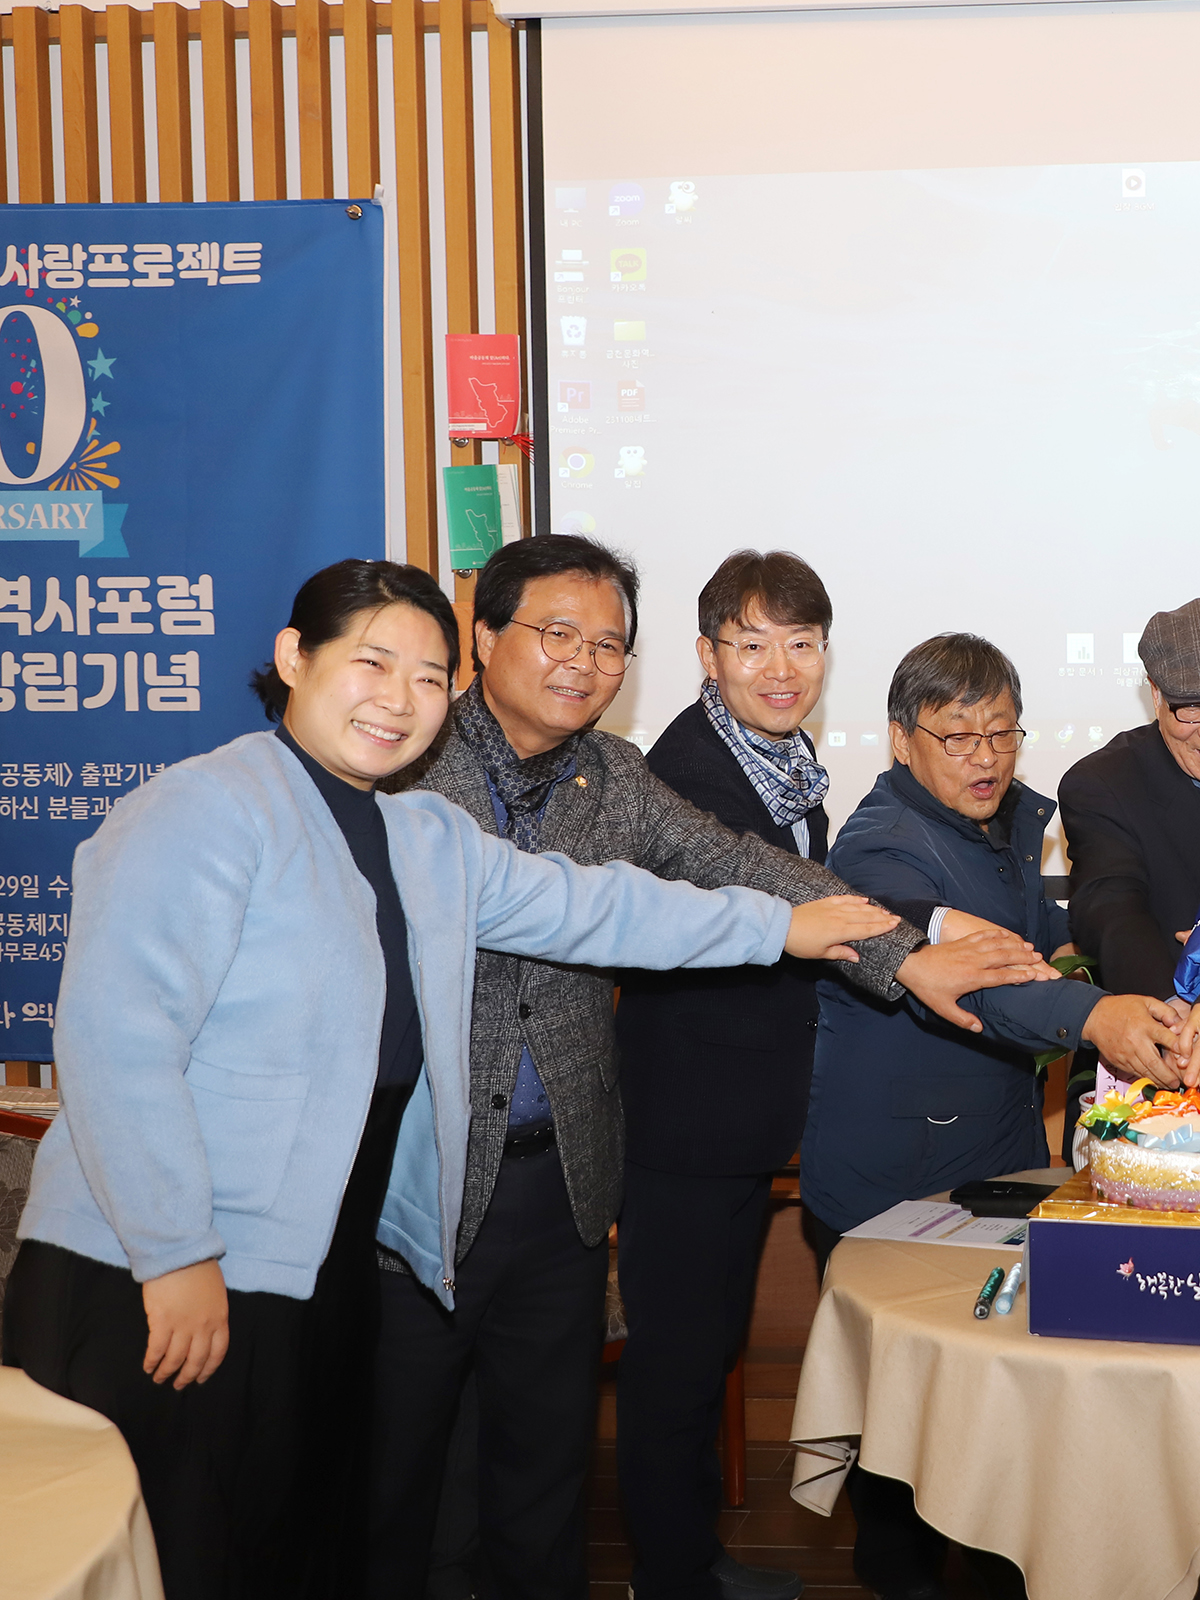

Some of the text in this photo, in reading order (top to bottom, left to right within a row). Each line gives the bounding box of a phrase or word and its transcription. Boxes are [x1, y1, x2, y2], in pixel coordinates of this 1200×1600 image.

[614, 194, 640, 203] zoom
[616, 218, 640, 227] Zoom
[0, 241, 263, 289] 사랑프로젝트
[618, 260, 640, 268] TALK
[557, 285, 590, 296] Bonjour
[611, 283, 647, 292] 카카오톡
[622, 359, 639, 369] 사진
[566, 387, 584, 403] Pr
[621, 388, 639, 397] PDF
[562, 415, 589, 425] Adobe
[550, 425, 586, 435] Premiere
[561, 480, 593, 490] Chrome
[0, 796, 39, 820] 하신
[0, 913, 68, 937] 동체지
[0, 942, 68, 963] 무로45)
